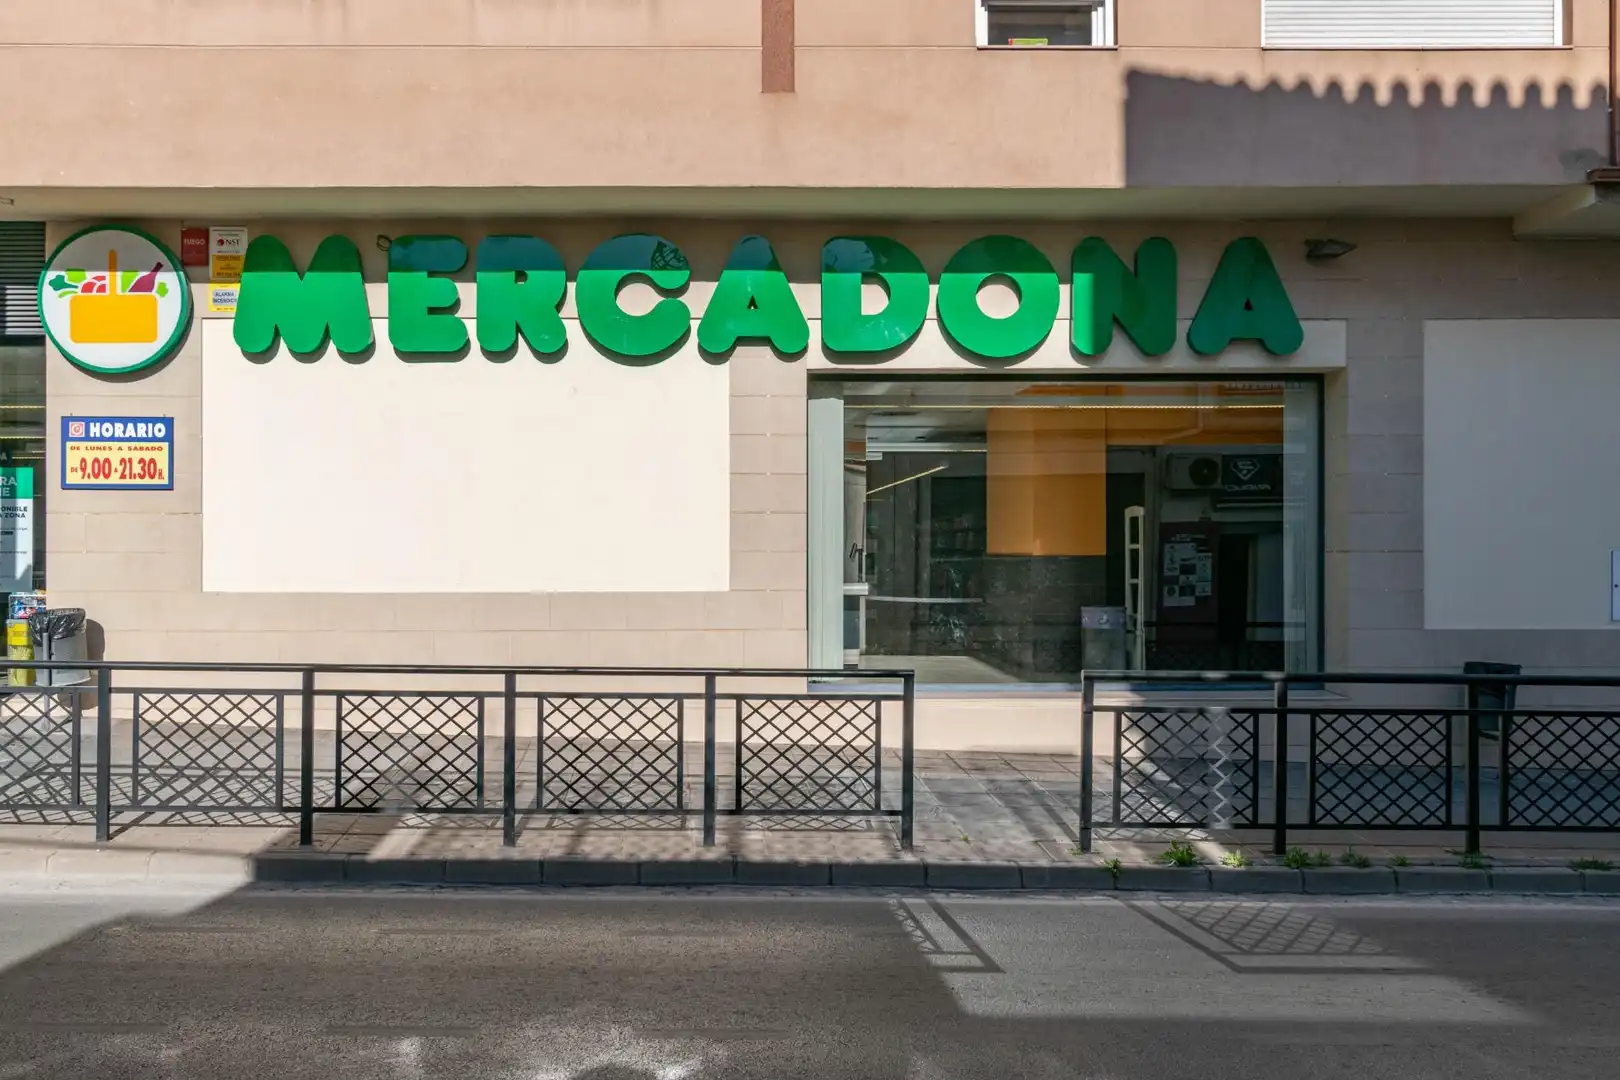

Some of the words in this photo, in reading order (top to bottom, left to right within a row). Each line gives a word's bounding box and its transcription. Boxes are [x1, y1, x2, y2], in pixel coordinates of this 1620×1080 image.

[233, 234, 1304, 359] MERCADONA
[89, 422, 166, 438] HORARIO
[79, 457, 112, 480] 9.00
[119, 457, 157, 480] 21.30
